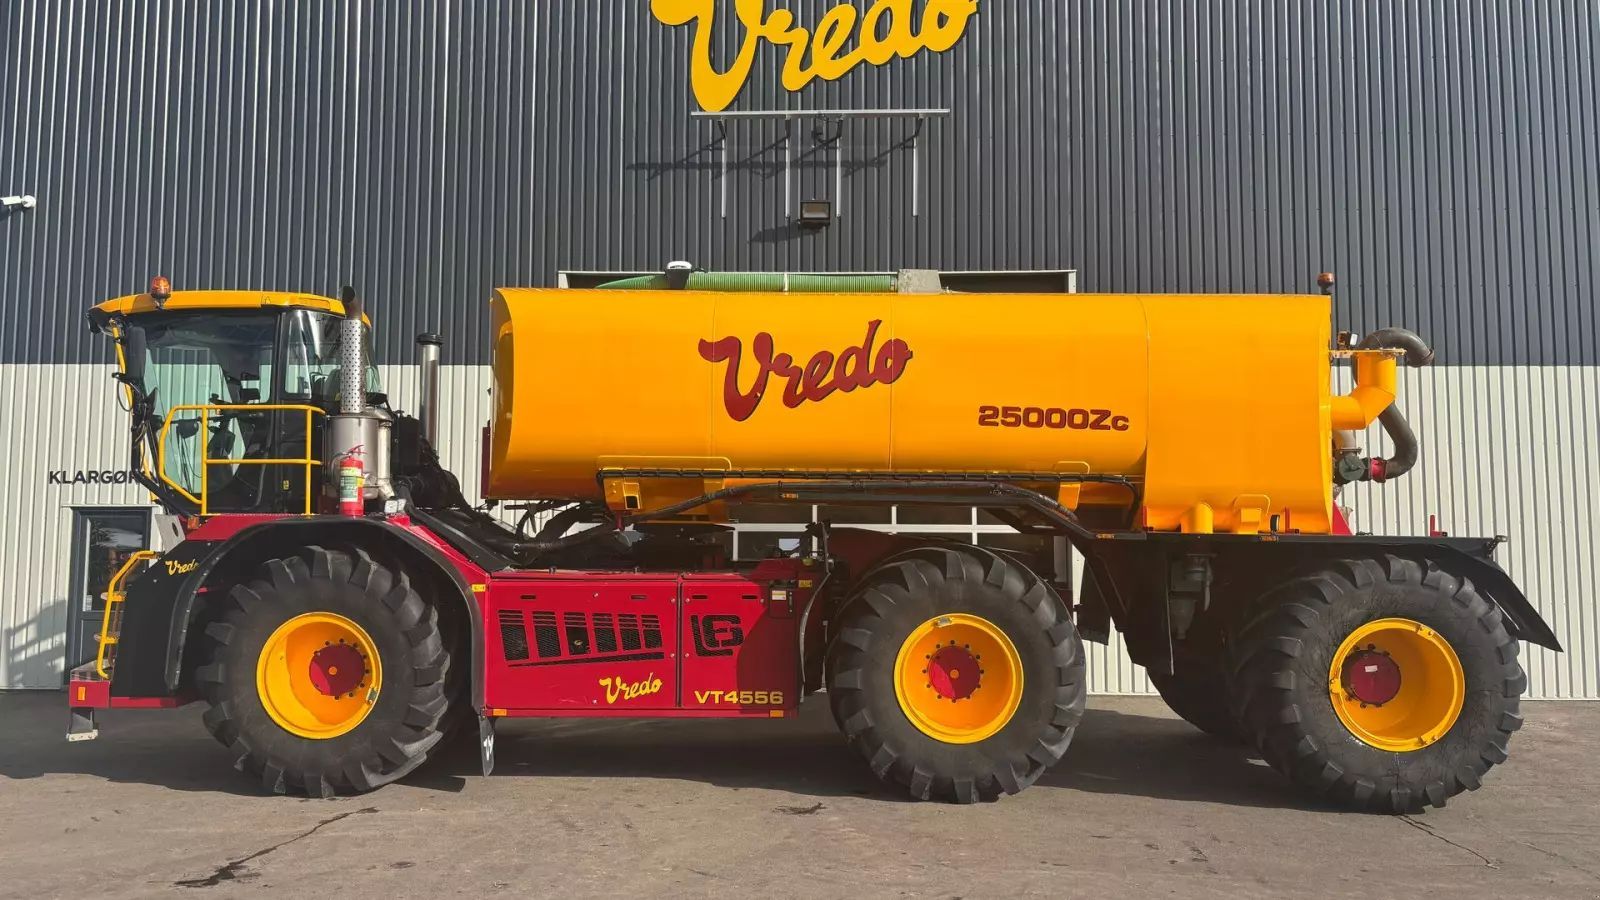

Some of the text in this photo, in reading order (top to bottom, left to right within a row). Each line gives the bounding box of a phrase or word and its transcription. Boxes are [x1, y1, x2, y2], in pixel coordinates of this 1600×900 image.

[650, 0, 977, 112] Vredo
[698, 319, 913, 421] Vredo
[978, 405, 1130, 431] 25000Zc
[599, 672, 663, 704] Vredo
[694, 690, 784, 704] VT4556
